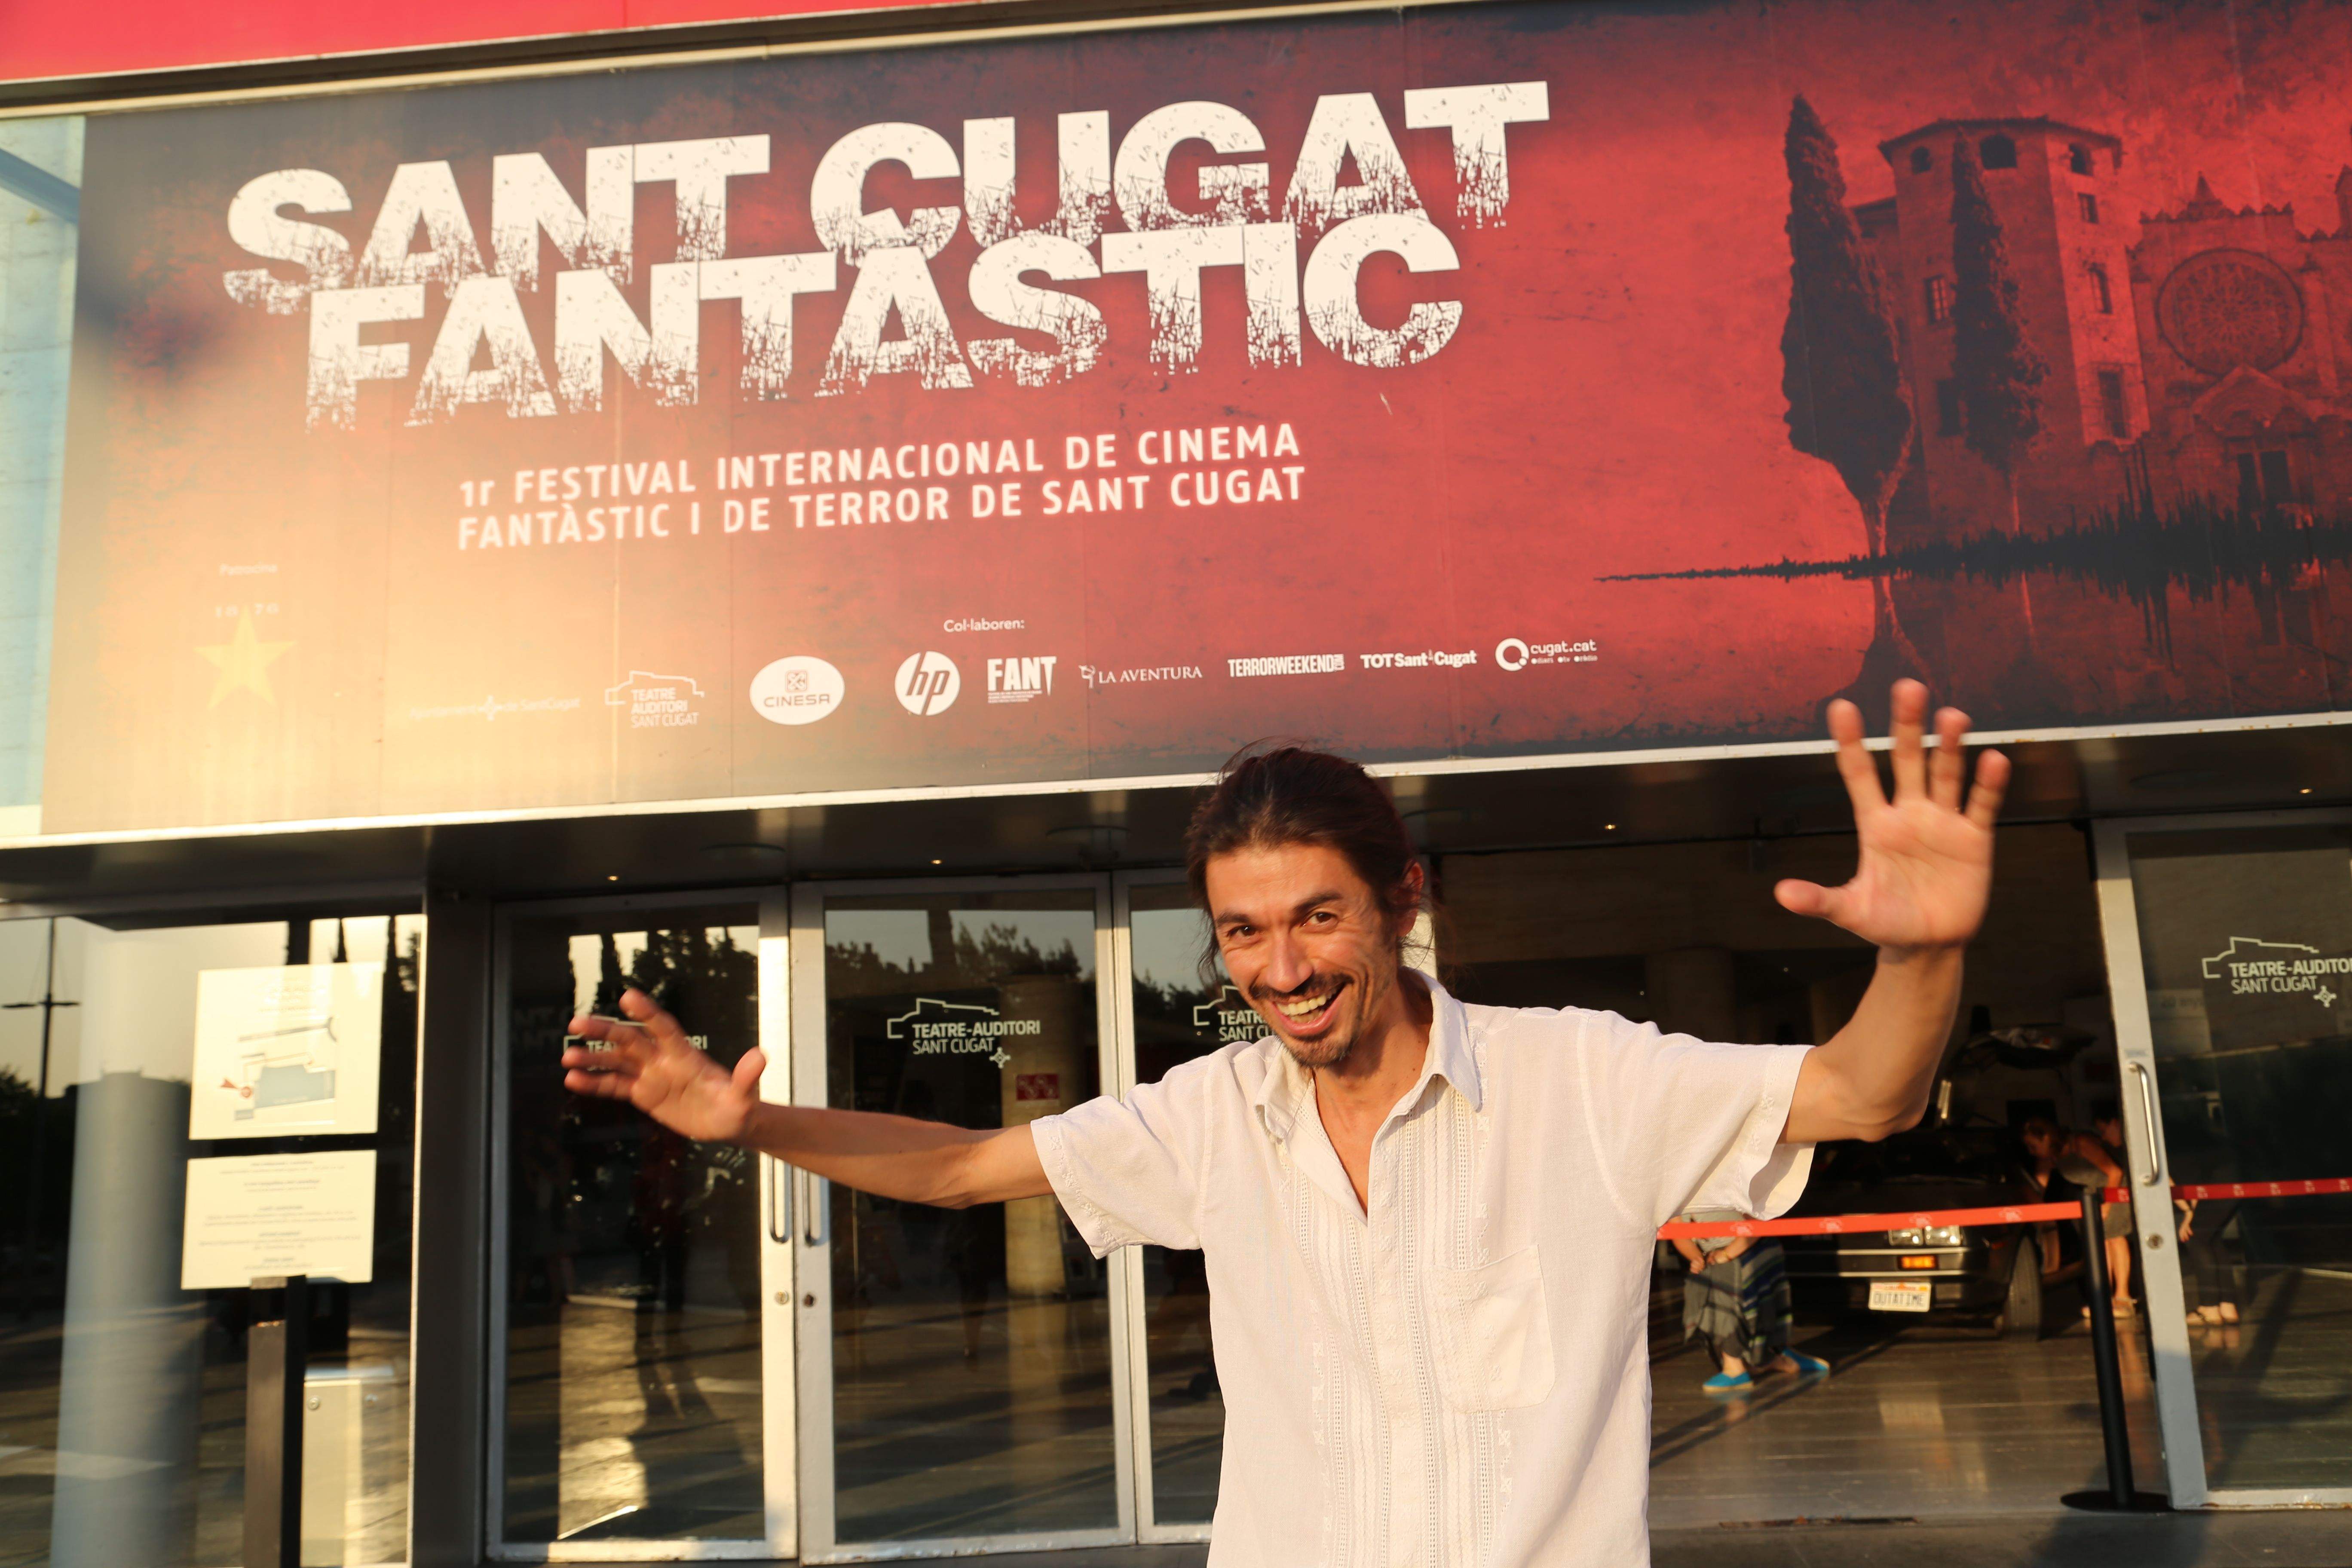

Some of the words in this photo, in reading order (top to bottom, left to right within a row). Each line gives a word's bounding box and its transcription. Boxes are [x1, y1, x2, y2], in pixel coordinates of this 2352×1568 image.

[222, 133, 770, 315] SANT
[810, 80, 1550, 267] CUGAT
[459, 479, 495, 508] 1r
[514, 459, 696, 504] FESTIVAL
[717, 438, 1044, 490] INTERNACIONAL
[1065, 434, 1117, 470] DE
[1137, 423, 1300, 466] CINEMA
[458, 503, 670, 551] FANTÀSTIC
[690, 502, 700, 535] I
[723, 497, 771, 533] DE
[788, 486, 949, 529] TERROR
[971, 482, 1022, 518] DE
[1041, 475, 1151, 515] SANT
[1170, 466, 1306, 507] CUGAT
[1530, 639, 1597, 656] cugat.cat
[1433, 649, 1477, 668] Cugat
[903, 651, 952, 716] hp
[987, 655, 1057, 697] FANT
[1098, 670, 1117, 684] LA
[1120, 666, 1203, 683] AVENTURA
[630, 687, 677, 701] TEATRE
[763, 692, 831, 709] CINESA
[631, 700, 688, 714] AUDITORI
[630, 714, 661, 729] SANT
[662, 712, 700, 726] CUGAT
[2228, 958, 2352, 978] TEATRE-AUDITO
[2231, 977, 2269, 995] SANT
[2270, 975, 2318, 993] CUGAT
[912, 1020, 1041, 1038] TEATRE-AUDITORI
[1219, 1025, 1255, 1042] SANT
[913, 1038, 949, 1055] SANT
[950, 1037, 995, 1054] CUGAT
